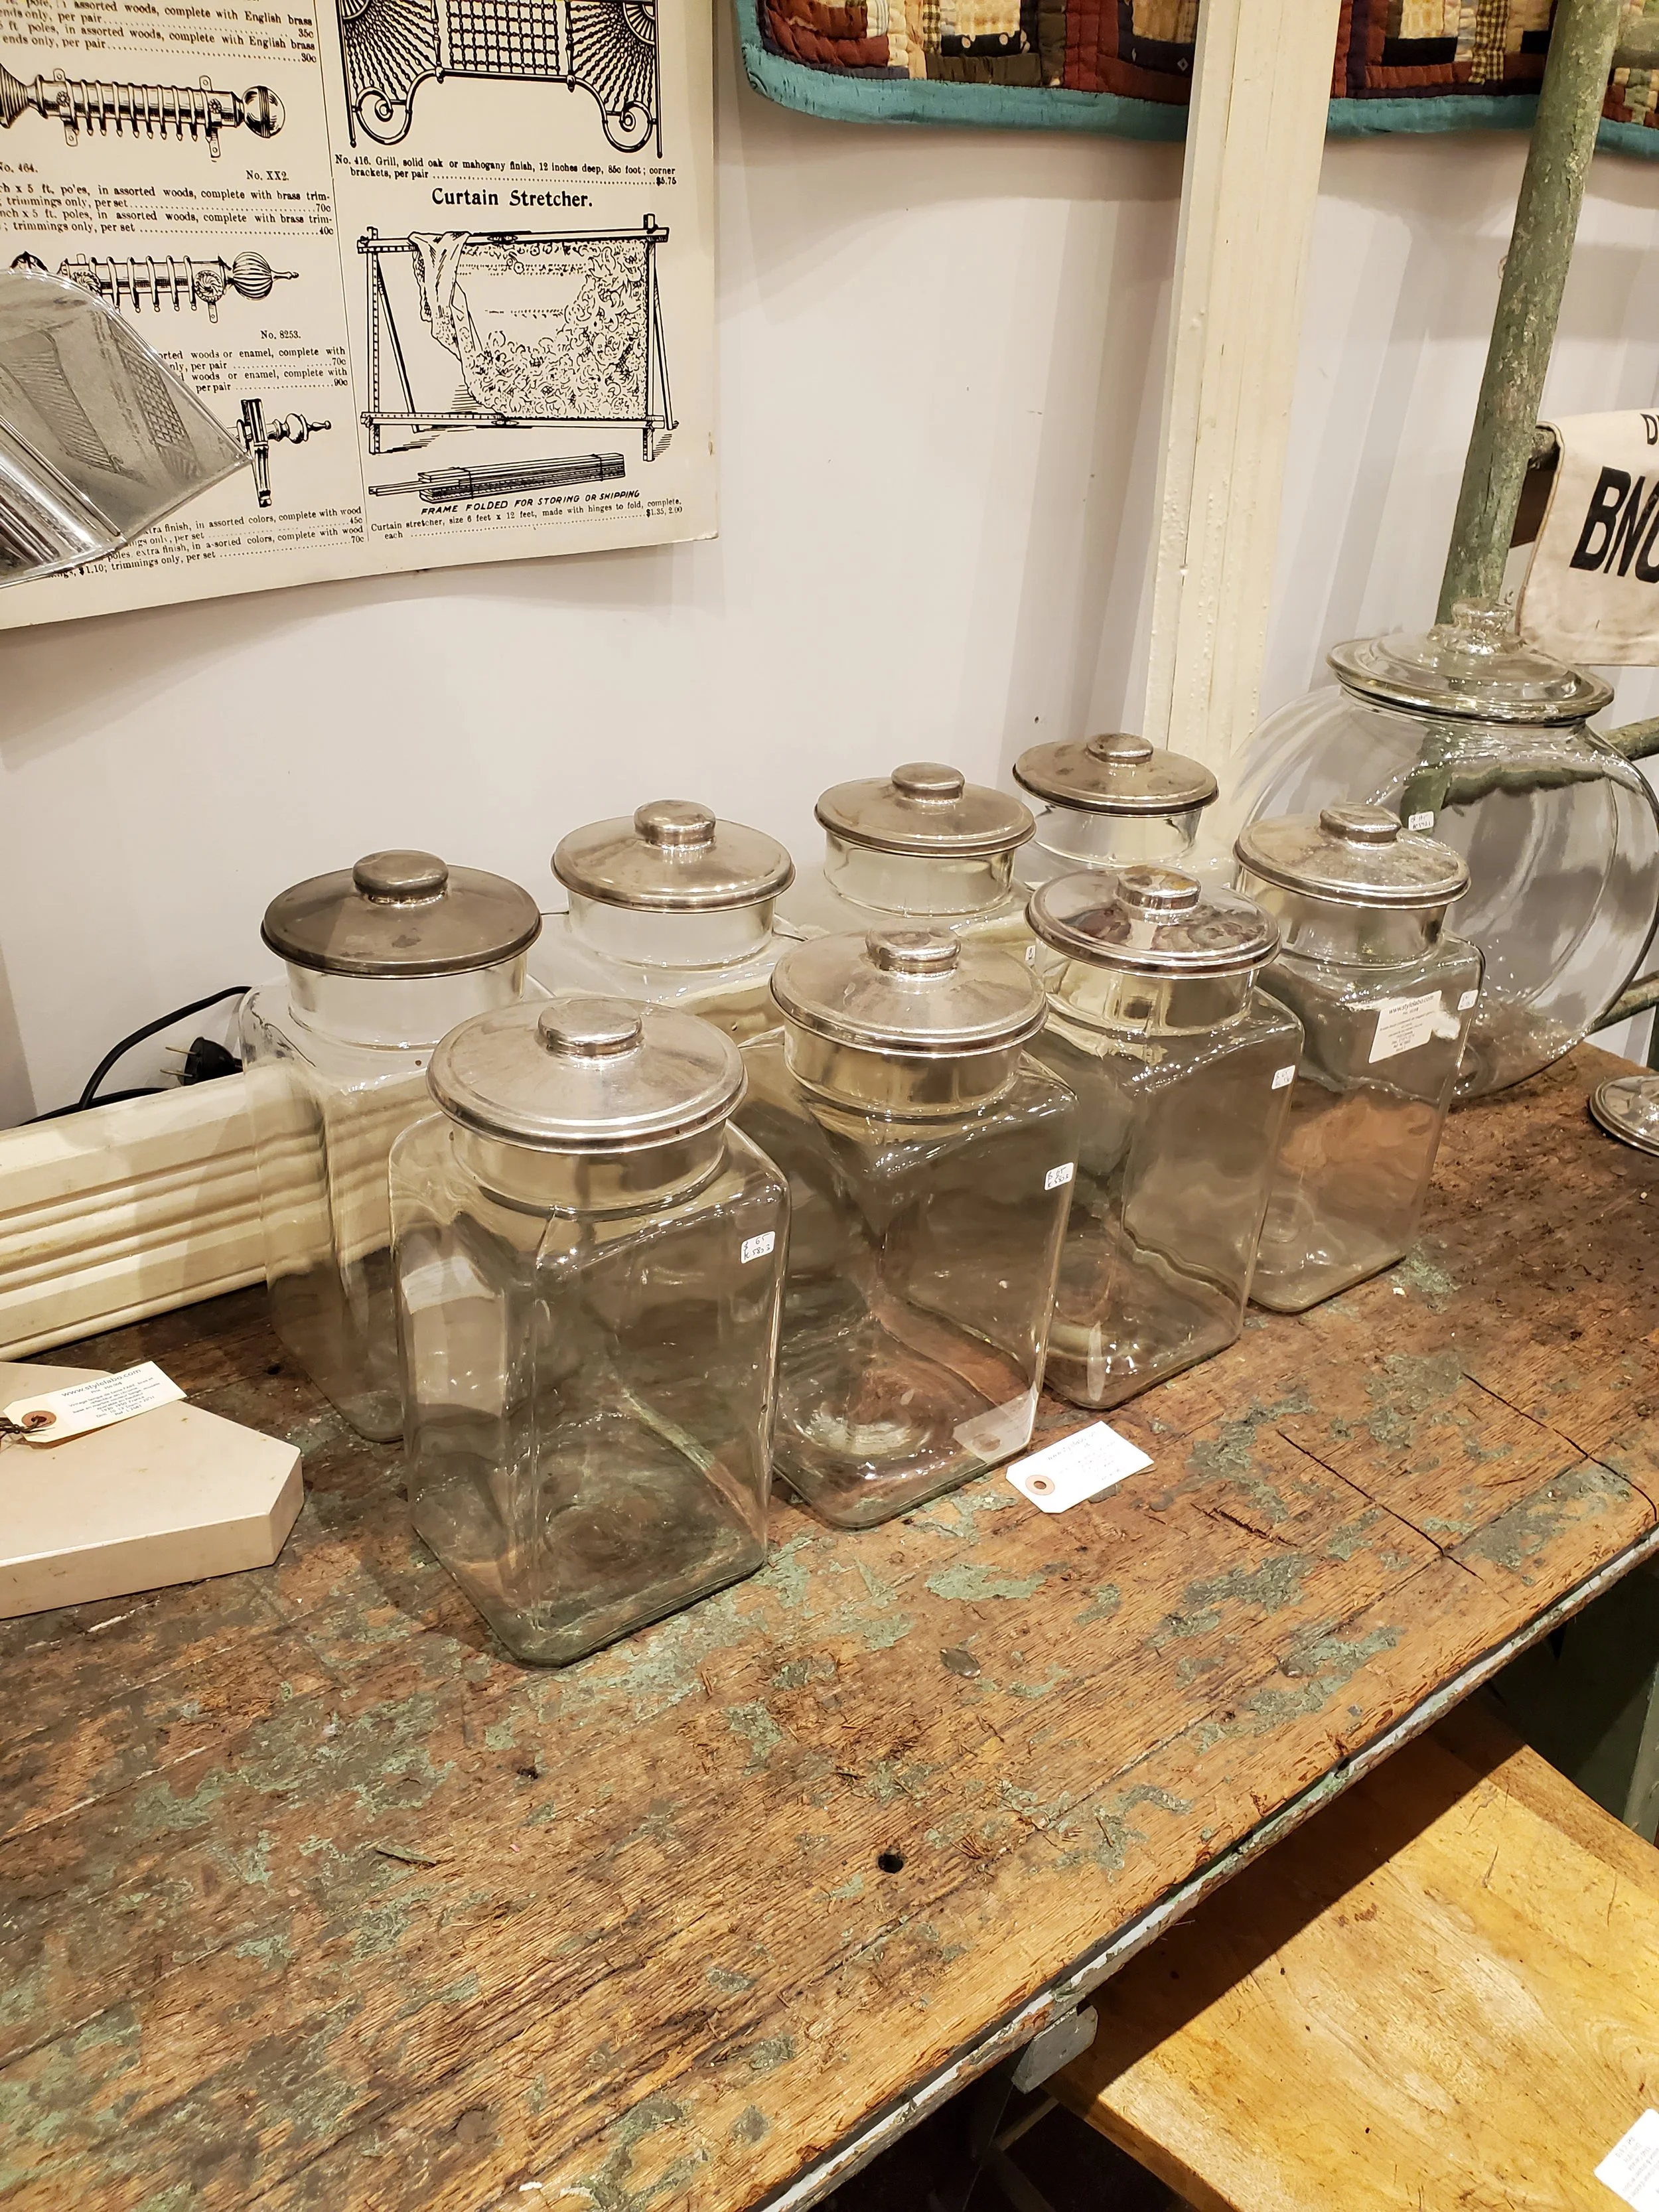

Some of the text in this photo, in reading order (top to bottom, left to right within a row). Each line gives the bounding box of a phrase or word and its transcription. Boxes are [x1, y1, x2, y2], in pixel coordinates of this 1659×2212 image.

[25, 9, 52, 23] only,
[58, 13, 75, 24] per
[74, 0, 117, 11] assorted
[124, 3, 159, 17] woods,
[165, 6, 210, 19] complete
[216, 9, 238, 20] with
[244, 11, 281, 24] English
[287, 14, 313, 26] brass
[3, 33, 28, 44] ends
[32, 36, 58, 48] only,
[62, 39, 80, 48] per
[28, 22, 58, 35] poles,
[65, 24, 76, 34] in
[81, 27, 124, 37] assorted
[129, 29, 165, 42] woods,
[169, 32, 215, 44] complete
[222, 35, 244, 45] with
[250, 36, 285, 49] English
[290, 38, 315, 50] brass
[335, 154, 351, 165] No.
[376, 156, 399, 168] Grill,
[403, 157, 423, 167] solid
[428, 158, 443, 167] oak
[463, 159, 505, 172] mahogany
[510, 161, 535, 173] finish,
[552, 162, 577, 172] inches
[582, 163, 603, 175] deep,
[246, 170, 263, 181] No.
[350, 167, 391, 179] brackets,
[394, 171, 408, 180] per
[42, 184, 54, 194] ft.
[98, 184, 109, 194] in
[114, 186, 155, 196] assorted
[163, 187, 196, 200] woods,
[201, 188, 245, 201] complete
[251, 190, 272, 199] with
[277, 190, 301, 200] brass
[432, 188, 592, 207] Curtain Stretcher.
[7, 196, 62, 208] trimmings
[95, 199, 111, 210] per
[45, 208, 57, 218] ft.
[62, 209, 92, 221] poles,
[116, 210, 157, 220] assorted
[165, 212, 198, 223] woods,
[204, 212, 246, 224] complete
[255, 213, 275, 222] with
[280, 214, 304, 223] brass
[13, 220, 68, 233] trimmings
[100, 224, 117, 234] per
[260, 330, 301, 339] No. 8253.
[190, 350, 219, 358] woods
[240, 348, 273, 358] enamel,
[279, 347, 319, 358] complete
[190, 364, 206, 372] per
[209, 360, 227, 372] pair
[192, 372, 220, 380] woods
[245, 370, 279, 380] enamel,
[284, 368, 323, 379] complete
[1640, 413, 1659, 445] D
[421, 505, 459, 515] FRAME
[466, 500, 508, 511] FOLDED
[514, 498, 533, 508] FOR
[538, 495, 579, 505] STORING
[599, 490, 640, 500] SHIPPING
[165, 522, 191, 532] finish,
[209, 516, 244, 528] assorted
[249, 515, 275, 524] colors,
[279, 511, 316, 522] complete
[340, 506, 361, 515] wood
[371, 522, 401, 531] Curtain
[588, 504, 612, 513] hinges
[628, 500, 643, 509] fold,
[163, 544, 189, 553] finish,
[248, 536, 275, 544] colors,
[277, 529, 315, 541] complete
[342, 525, 363, 534] wood
[175, 535, 188, 544] per
[111, 559, 159, 570] trimmings
[161, 555, 183, 564] only,
[186, 554, 200, 563] per
